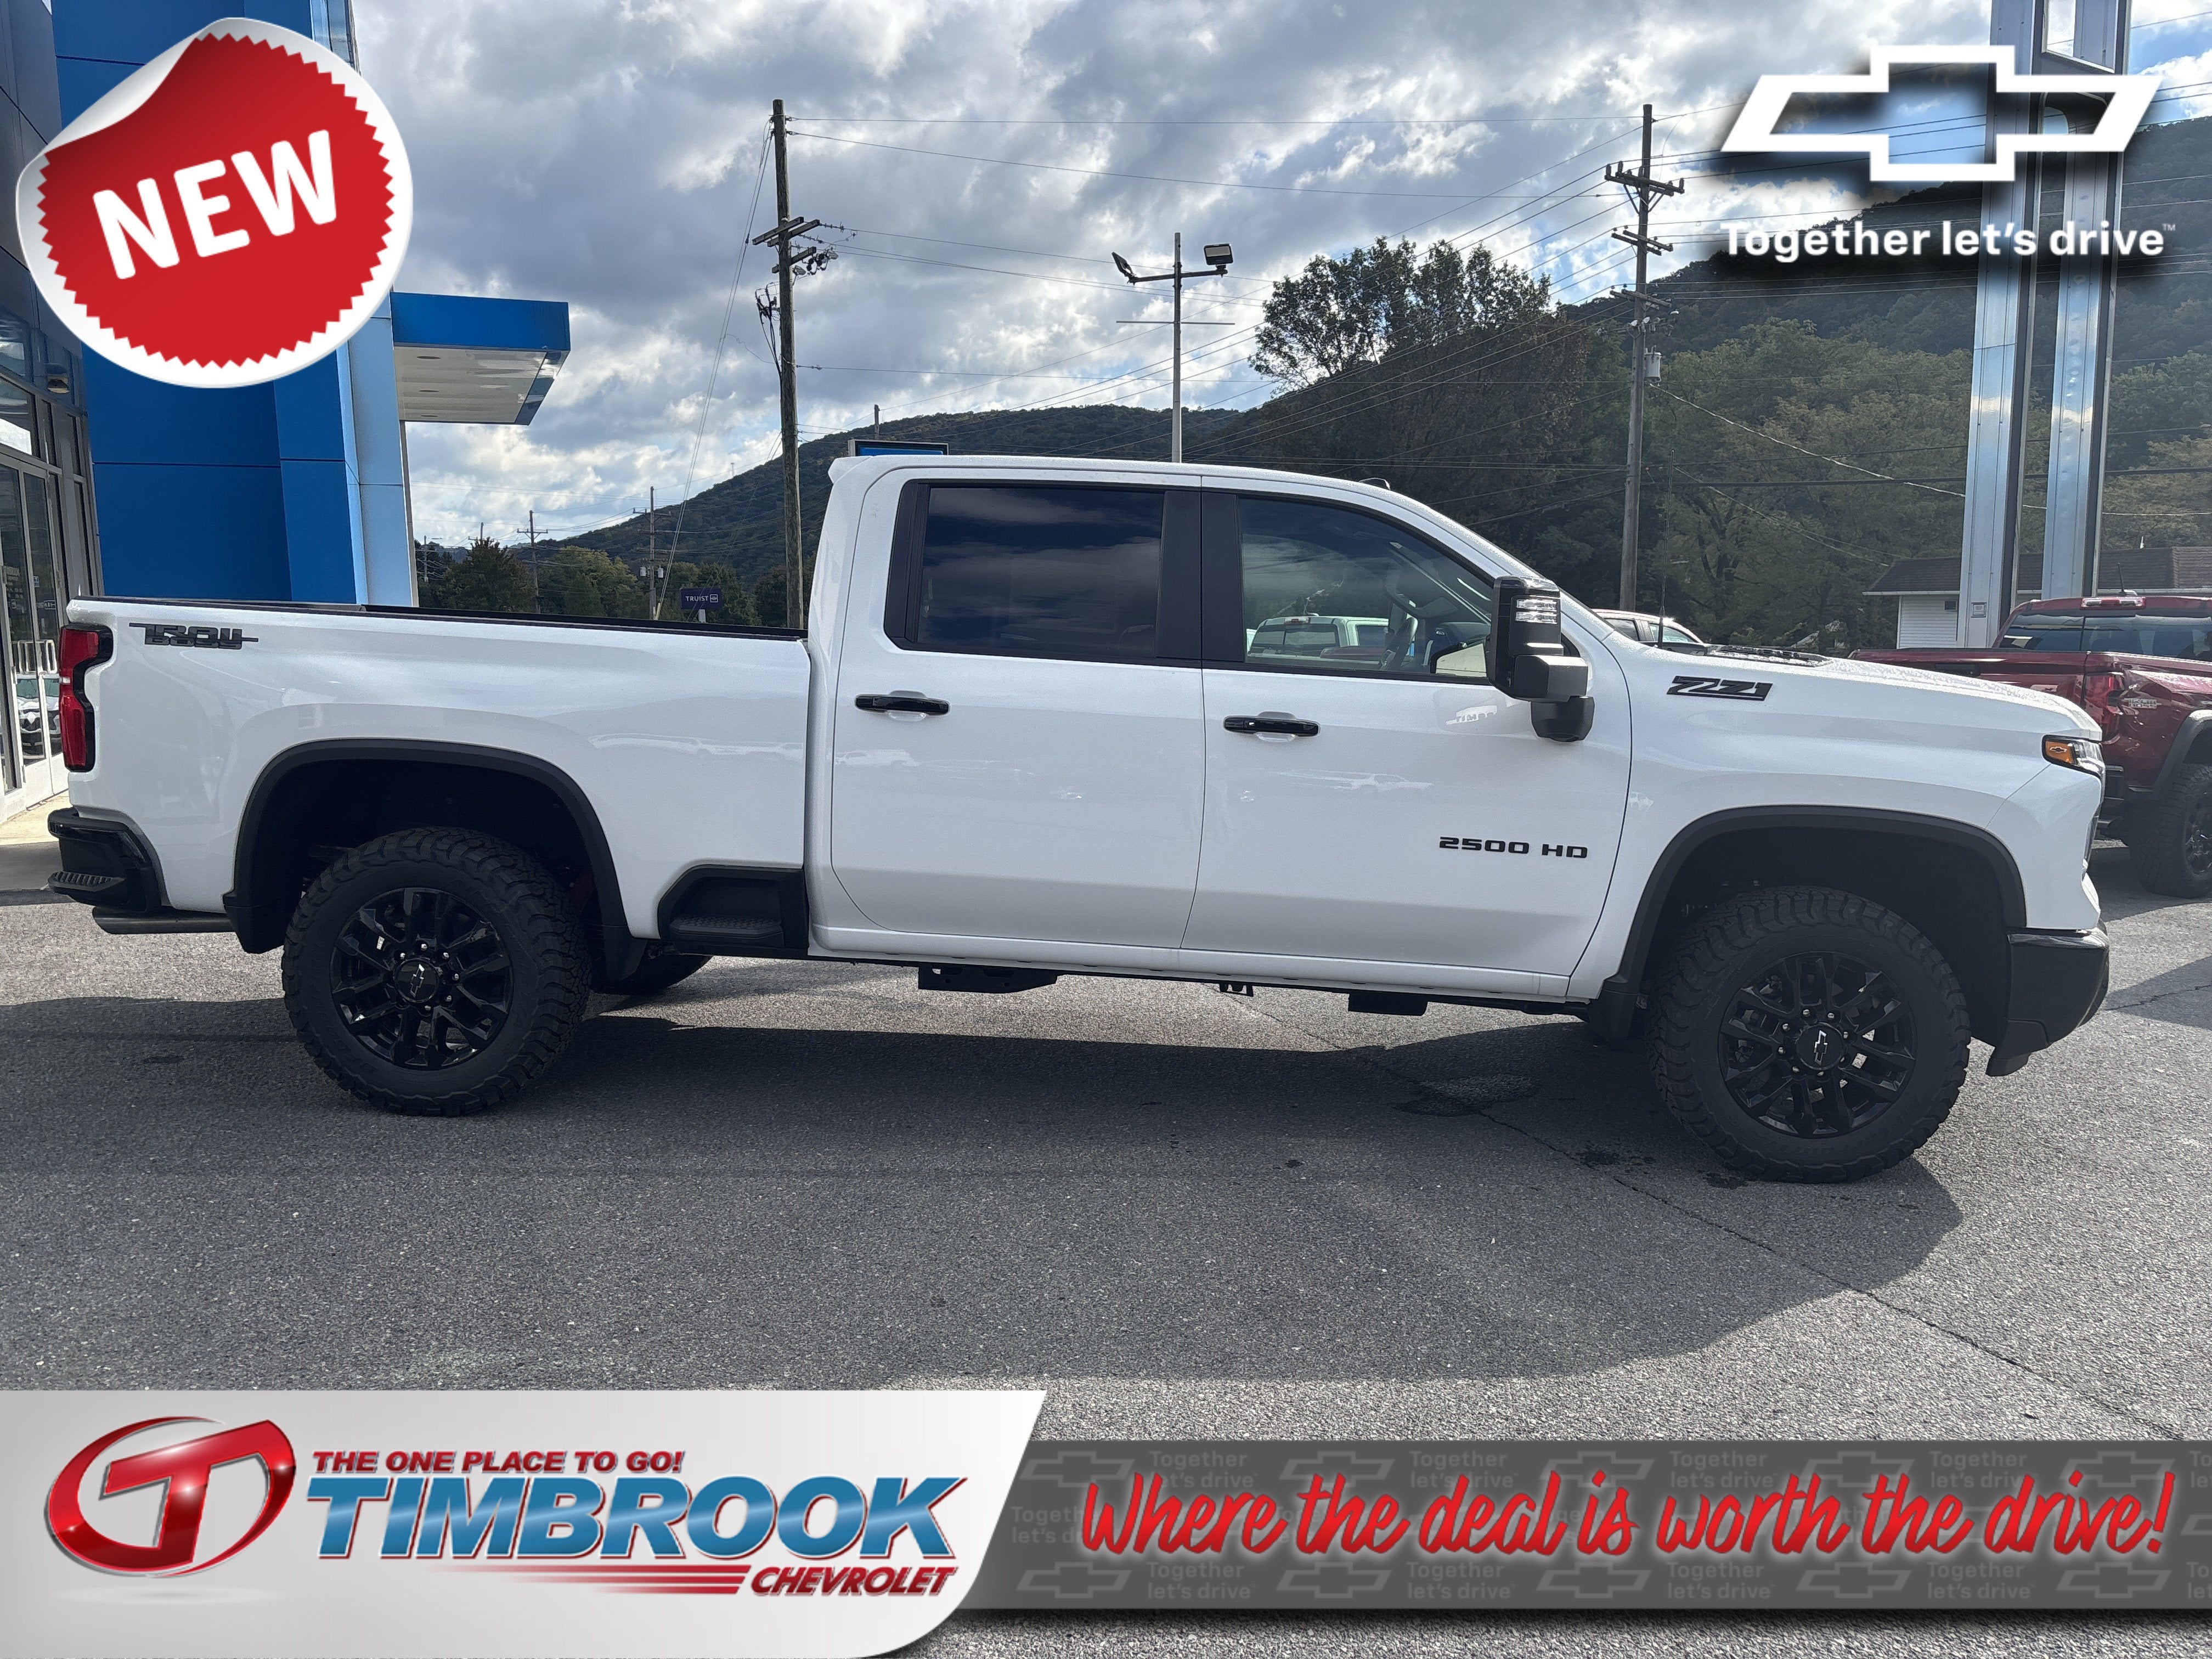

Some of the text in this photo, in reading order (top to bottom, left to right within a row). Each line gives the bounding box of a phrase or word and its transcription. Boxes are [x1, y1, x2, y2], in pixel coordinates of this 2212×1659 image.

[129, 622, 259, 646] TRAIL
[144, 635, 242, 650] BOSS
[1666, 675, 1773, 701] Z71
[1439, 836, 1588, 859] 2500 HD
